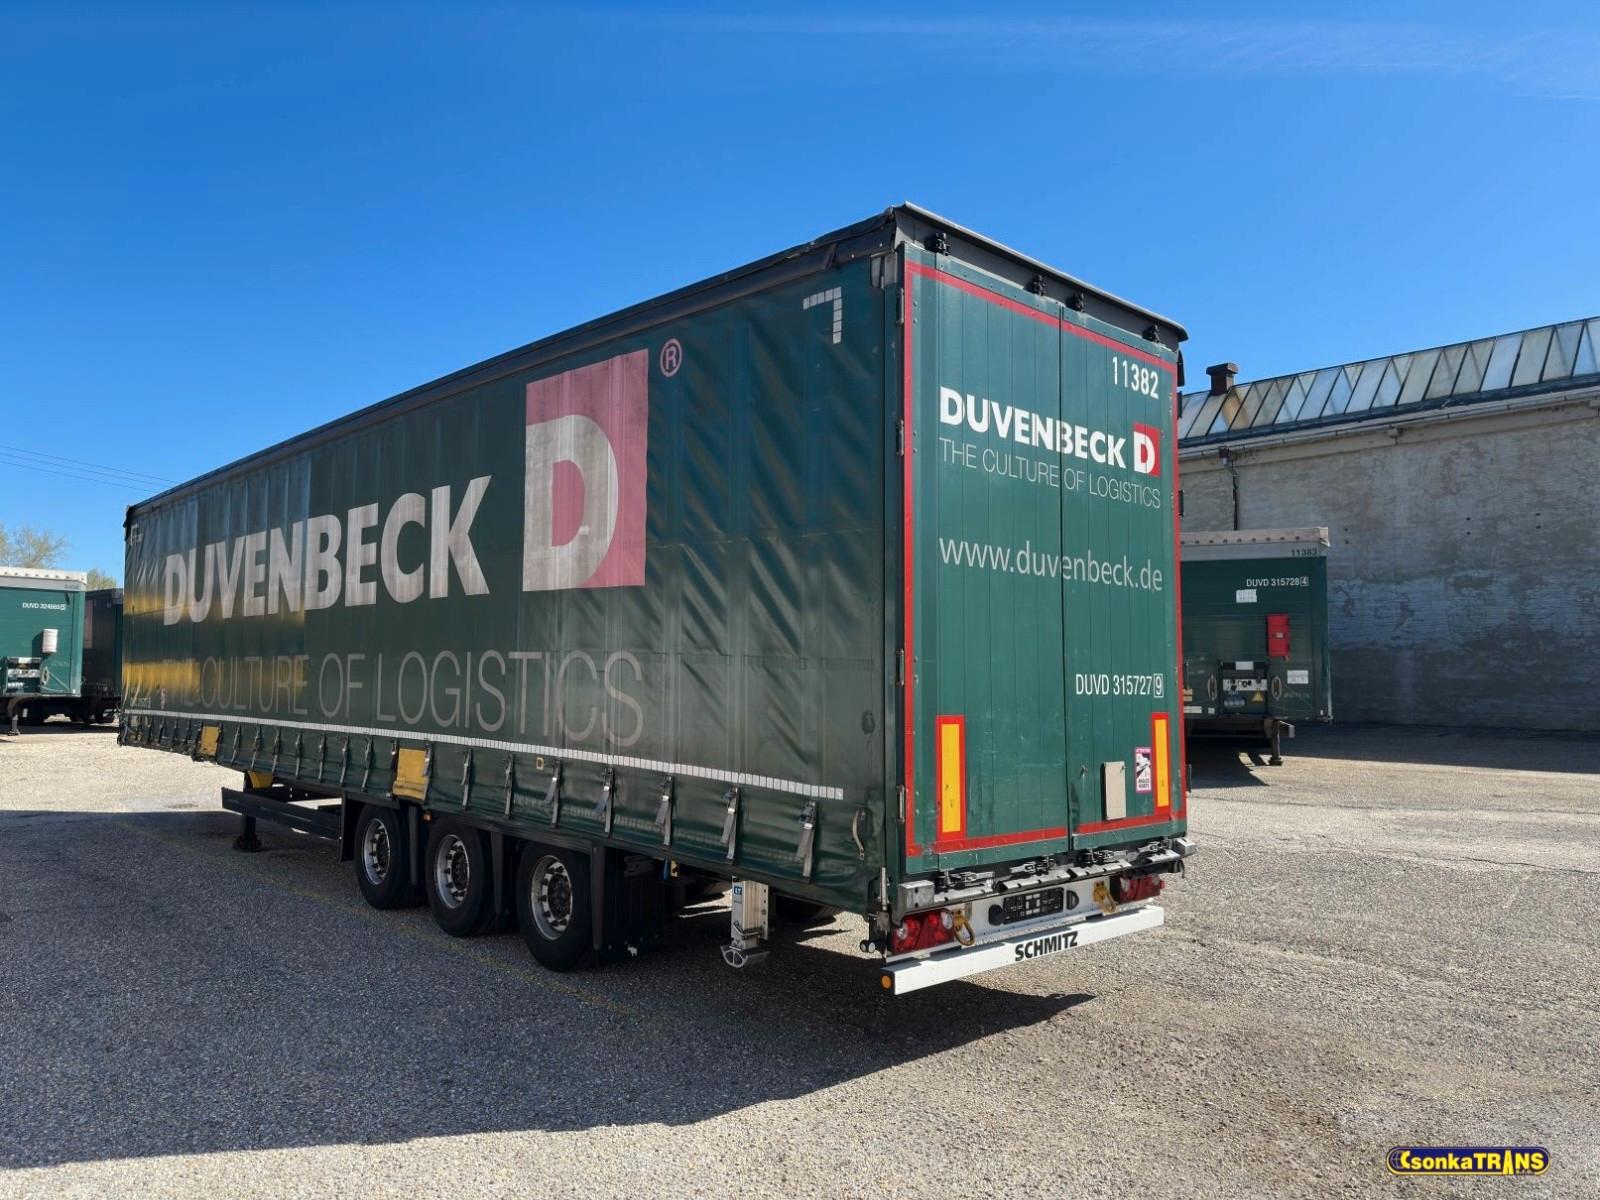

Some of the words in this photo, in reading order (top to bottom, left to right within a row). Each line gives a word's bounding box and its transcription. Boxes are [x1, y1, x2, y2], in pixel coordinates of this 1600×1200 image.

[1112, 356, 1159, 399] 11382
[939, 386, 1127, 470] DUVENBECK
[938, 437, 977, 469] THE
[982, 448, 1060, 488] CULTURE
[1063, 468, 1085, 491] OF
[1089, 474, 1161, 509] LOGISTICS
[162, 475, 492, 626] DUVENBECK
[938, 537, 1163, 592] www.duvenbeck.de
[1246, 578, 1269, 587] DUVD
[201, 654, 310, 716] CULTURE
[318, 652, 366, 719] OF
[375, 649, 644, 748] LOGISTICS
[1075, 673, 1110, 695] DUVD
[1014, 930, 1079, 962] SCHMITZ
